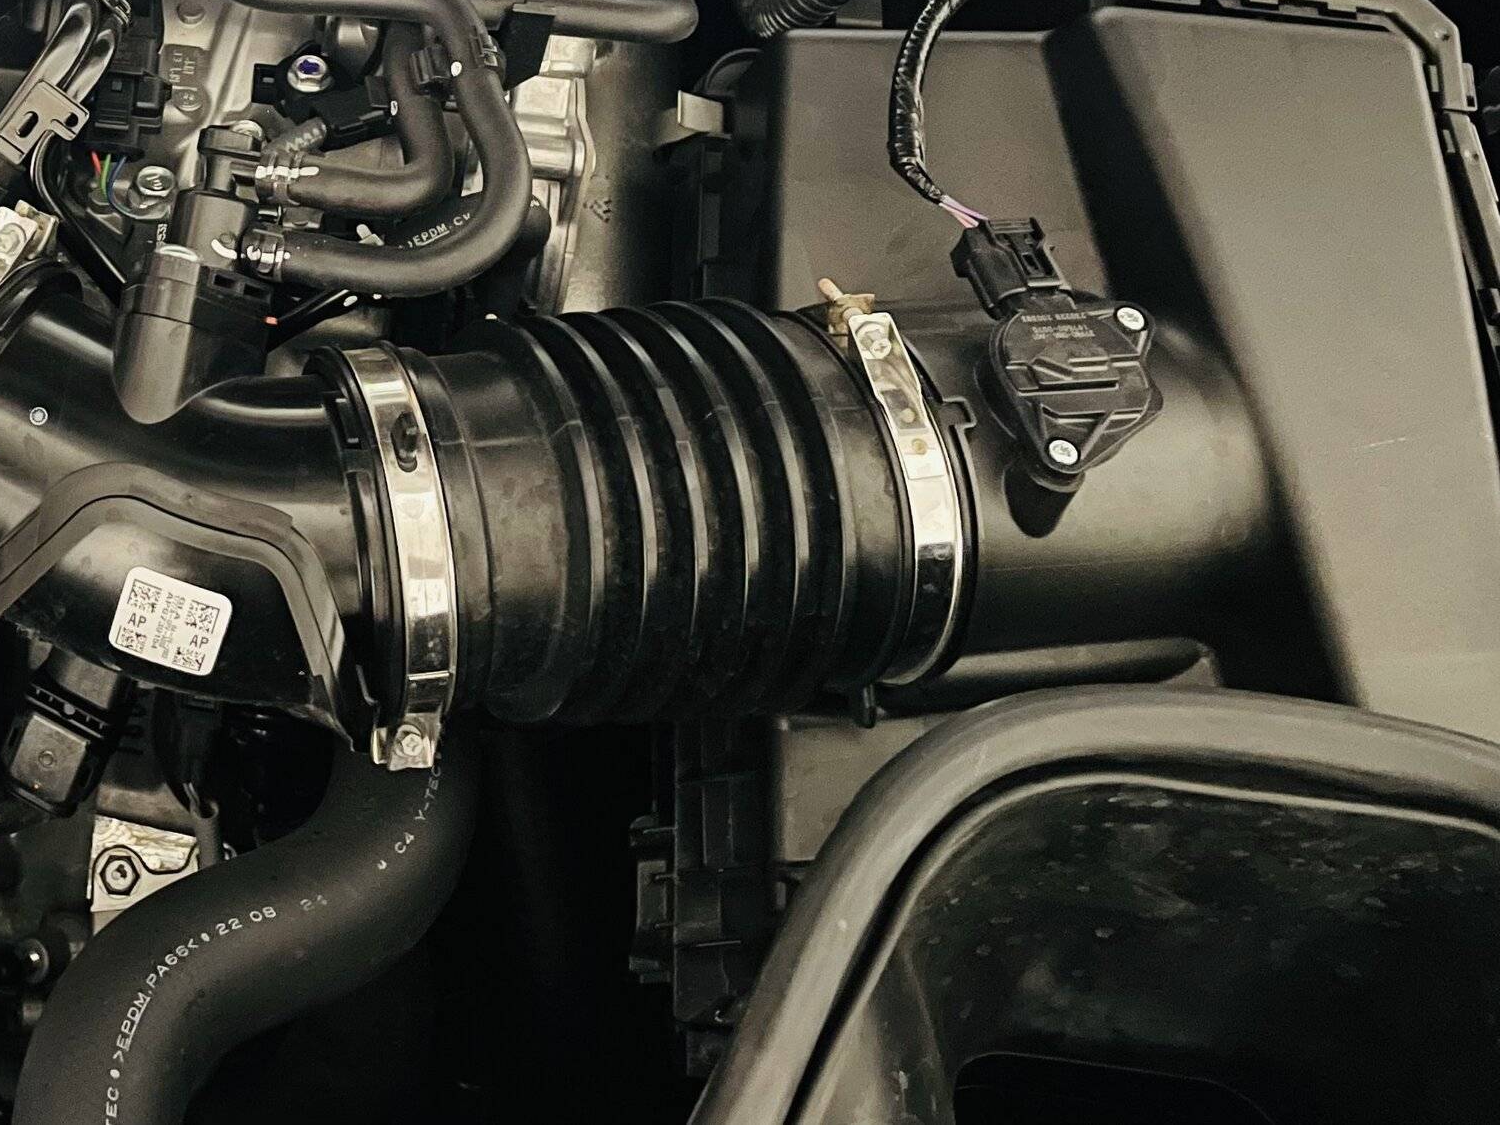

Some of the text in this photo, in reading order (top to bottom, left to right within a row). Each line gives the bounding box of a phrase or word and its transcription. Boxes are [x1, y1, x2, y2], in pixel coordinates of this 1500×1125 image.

[127, 612, 147, 628] AP
[189, 634, 209, 649] AP
[215, 917, 243, 936] 22
[249, 906, 277, 923] 08
